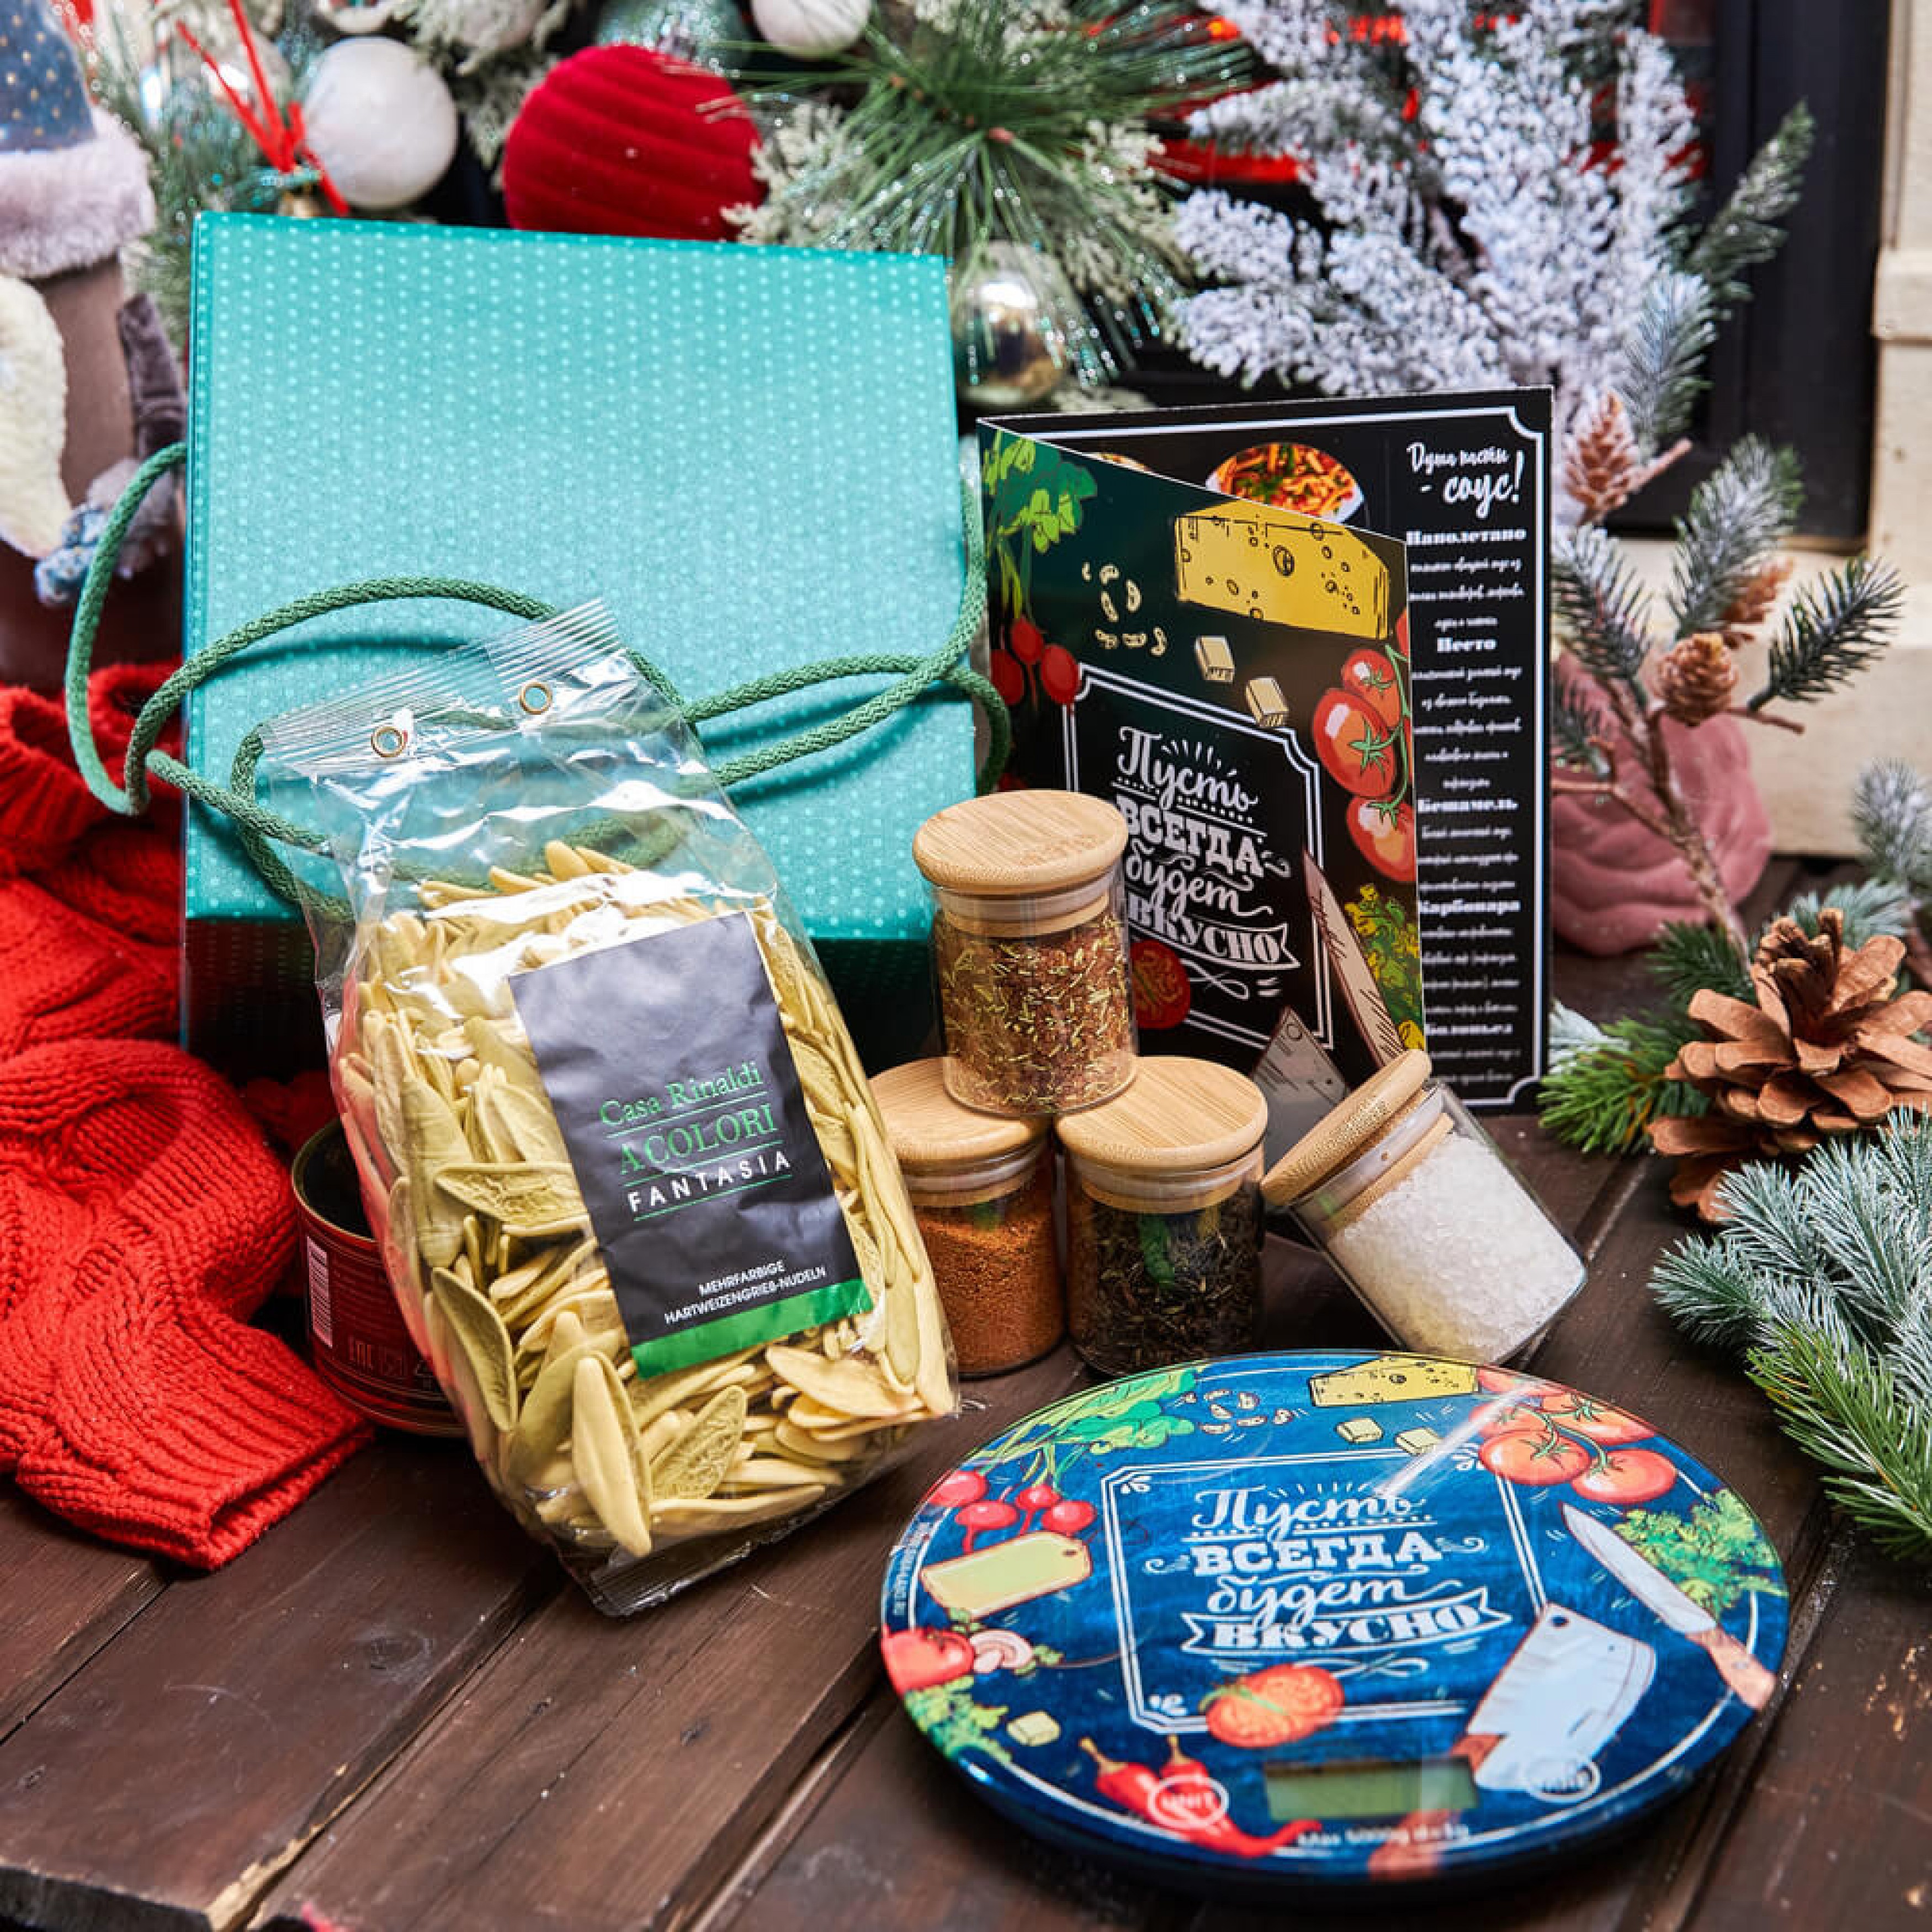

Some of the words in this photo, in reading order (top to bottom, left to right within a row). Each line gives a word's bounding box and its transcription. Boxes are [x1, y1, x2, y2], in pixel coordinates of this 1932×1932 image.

[1443, 450, 1525, 519] соус!
[1118, 726, 1259, 811] Пусть
[1116, 795, 1264, 878] ВСЕГДА
[1126, 839, 1273, 922] будет
[599, 1097, 662, 1127] Casa
[666, 1061, 763, 1108] Rinaldi
[620, 1143, 645, 1175] A
[643, 1104, 778, 1165] COLORI
[628, 1151, 790, 1212] FANTASIA
[664, 1266, 826, 1324] HARTWEIZENGRIEB-NUDELN
[698, 1260, 785, 1296] MEHRFARBIGE
[1191, 1486, 1427, 1541] Пусть
[1193, 1532, 1442, 1576] ВСЕГДА
[1207, 1577, 1463, 1627] будет
[1214, 1605, 1480, 1648] ВКУСНО
